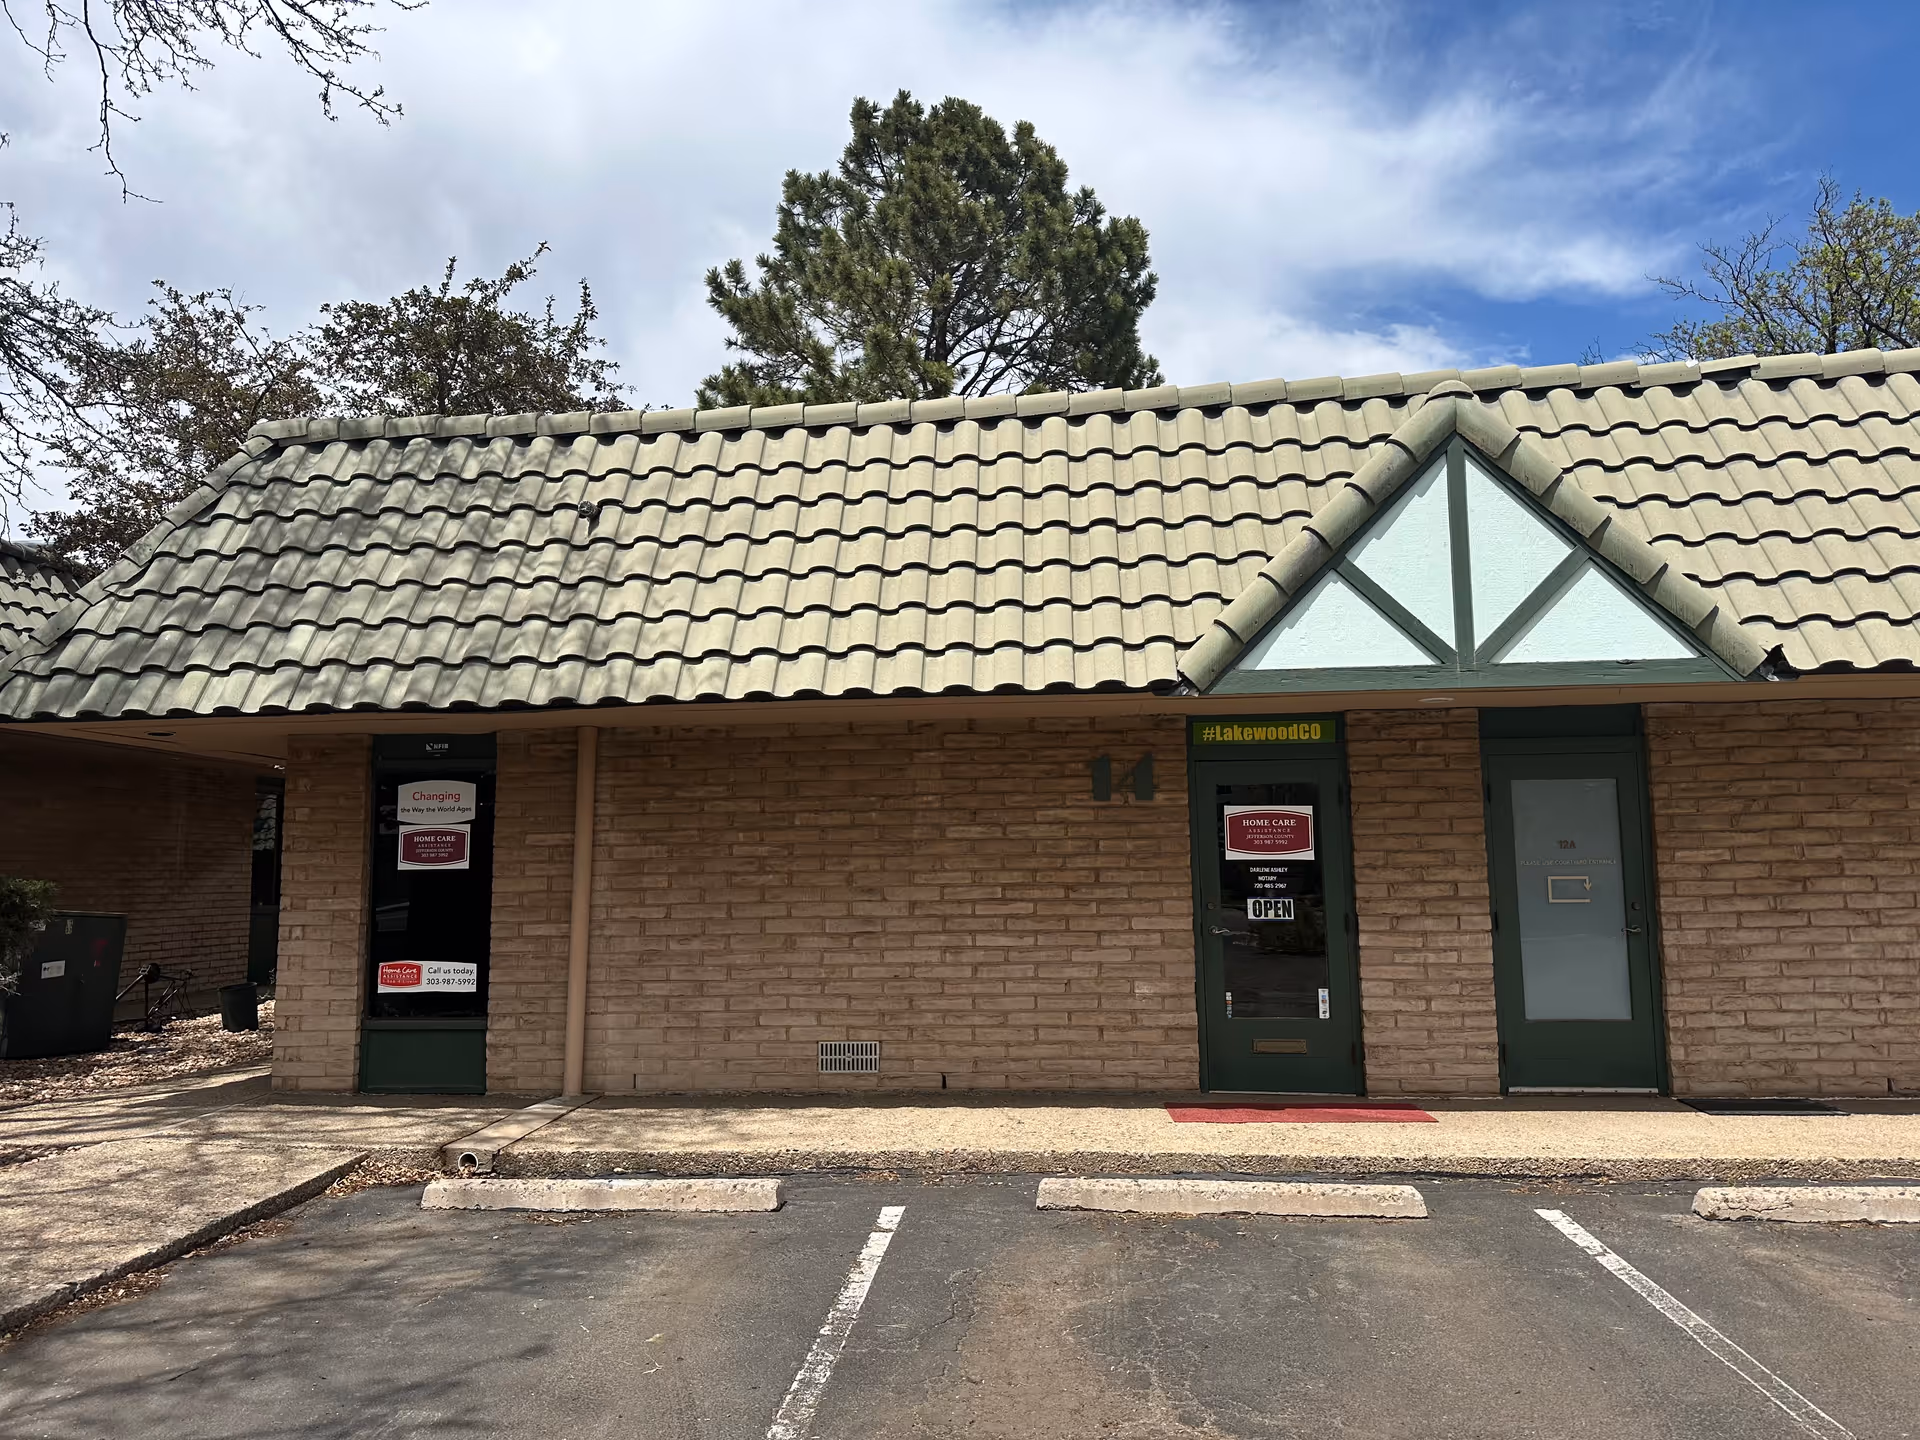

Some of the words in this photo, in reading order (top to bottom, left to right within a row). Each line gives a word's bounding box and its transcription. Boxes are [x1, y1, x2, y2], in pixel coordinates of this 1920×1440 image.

[1203, 723, 1321, 741] #LakewoodCO
[1090, 752, 1154, 801] 14
[412, 791, 461, 802] Changing
[411, 806, 425, 814] Way
[437, 805, 456, 813] World
[456, 805, 472, 814] Ages
[1252, 899, 1293, 919] OPEN
[382, 966, 401, 974] Home
[402, 966, 418, 974] Care
[426, 978, 476, 986] 303-987-5992
